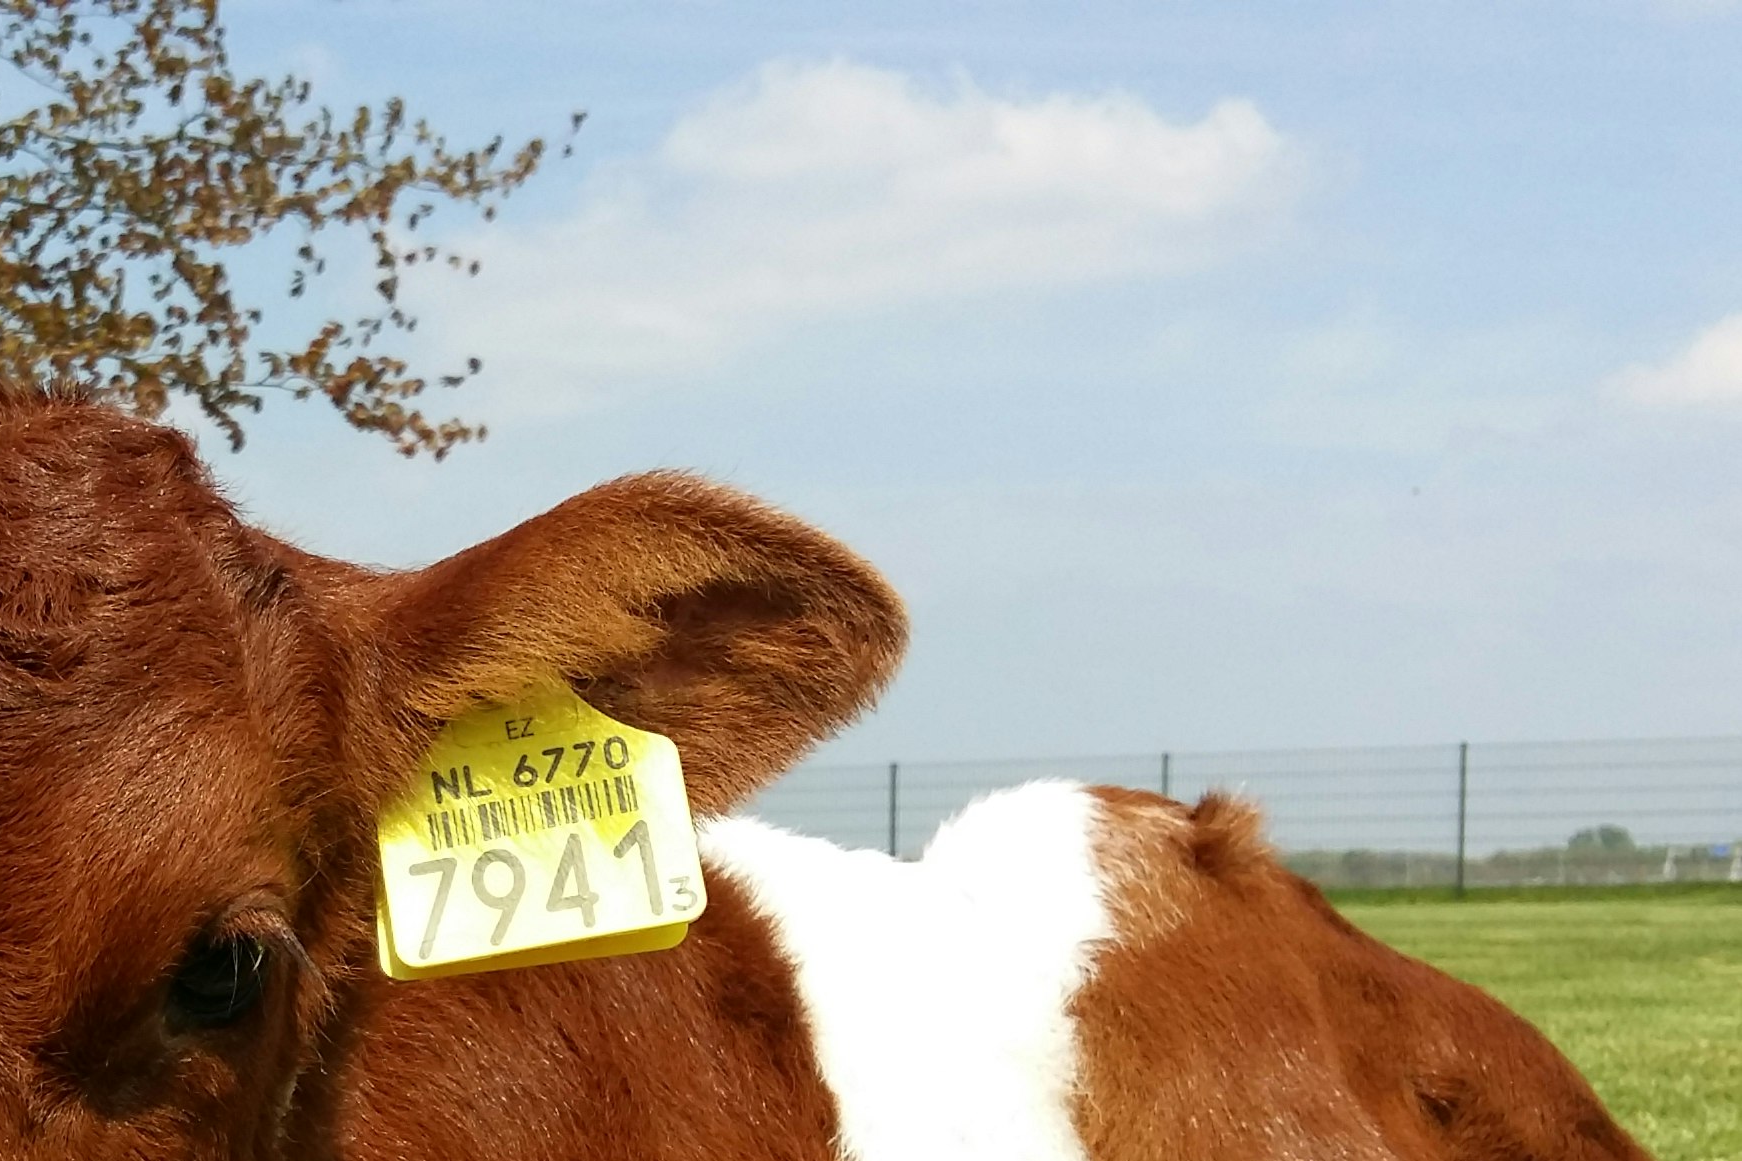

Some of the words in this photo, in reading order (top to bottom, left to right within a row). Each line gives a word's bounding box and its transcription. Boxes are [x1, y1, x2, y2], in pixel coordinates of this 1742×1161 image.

[505, 717, 535, 740] EZ
[430, 765, 492, 804] NL
[513, 735, 630, 788] 6770
[408, 820, 663, 960] 7941
[668, 876, 698, 911] 3
